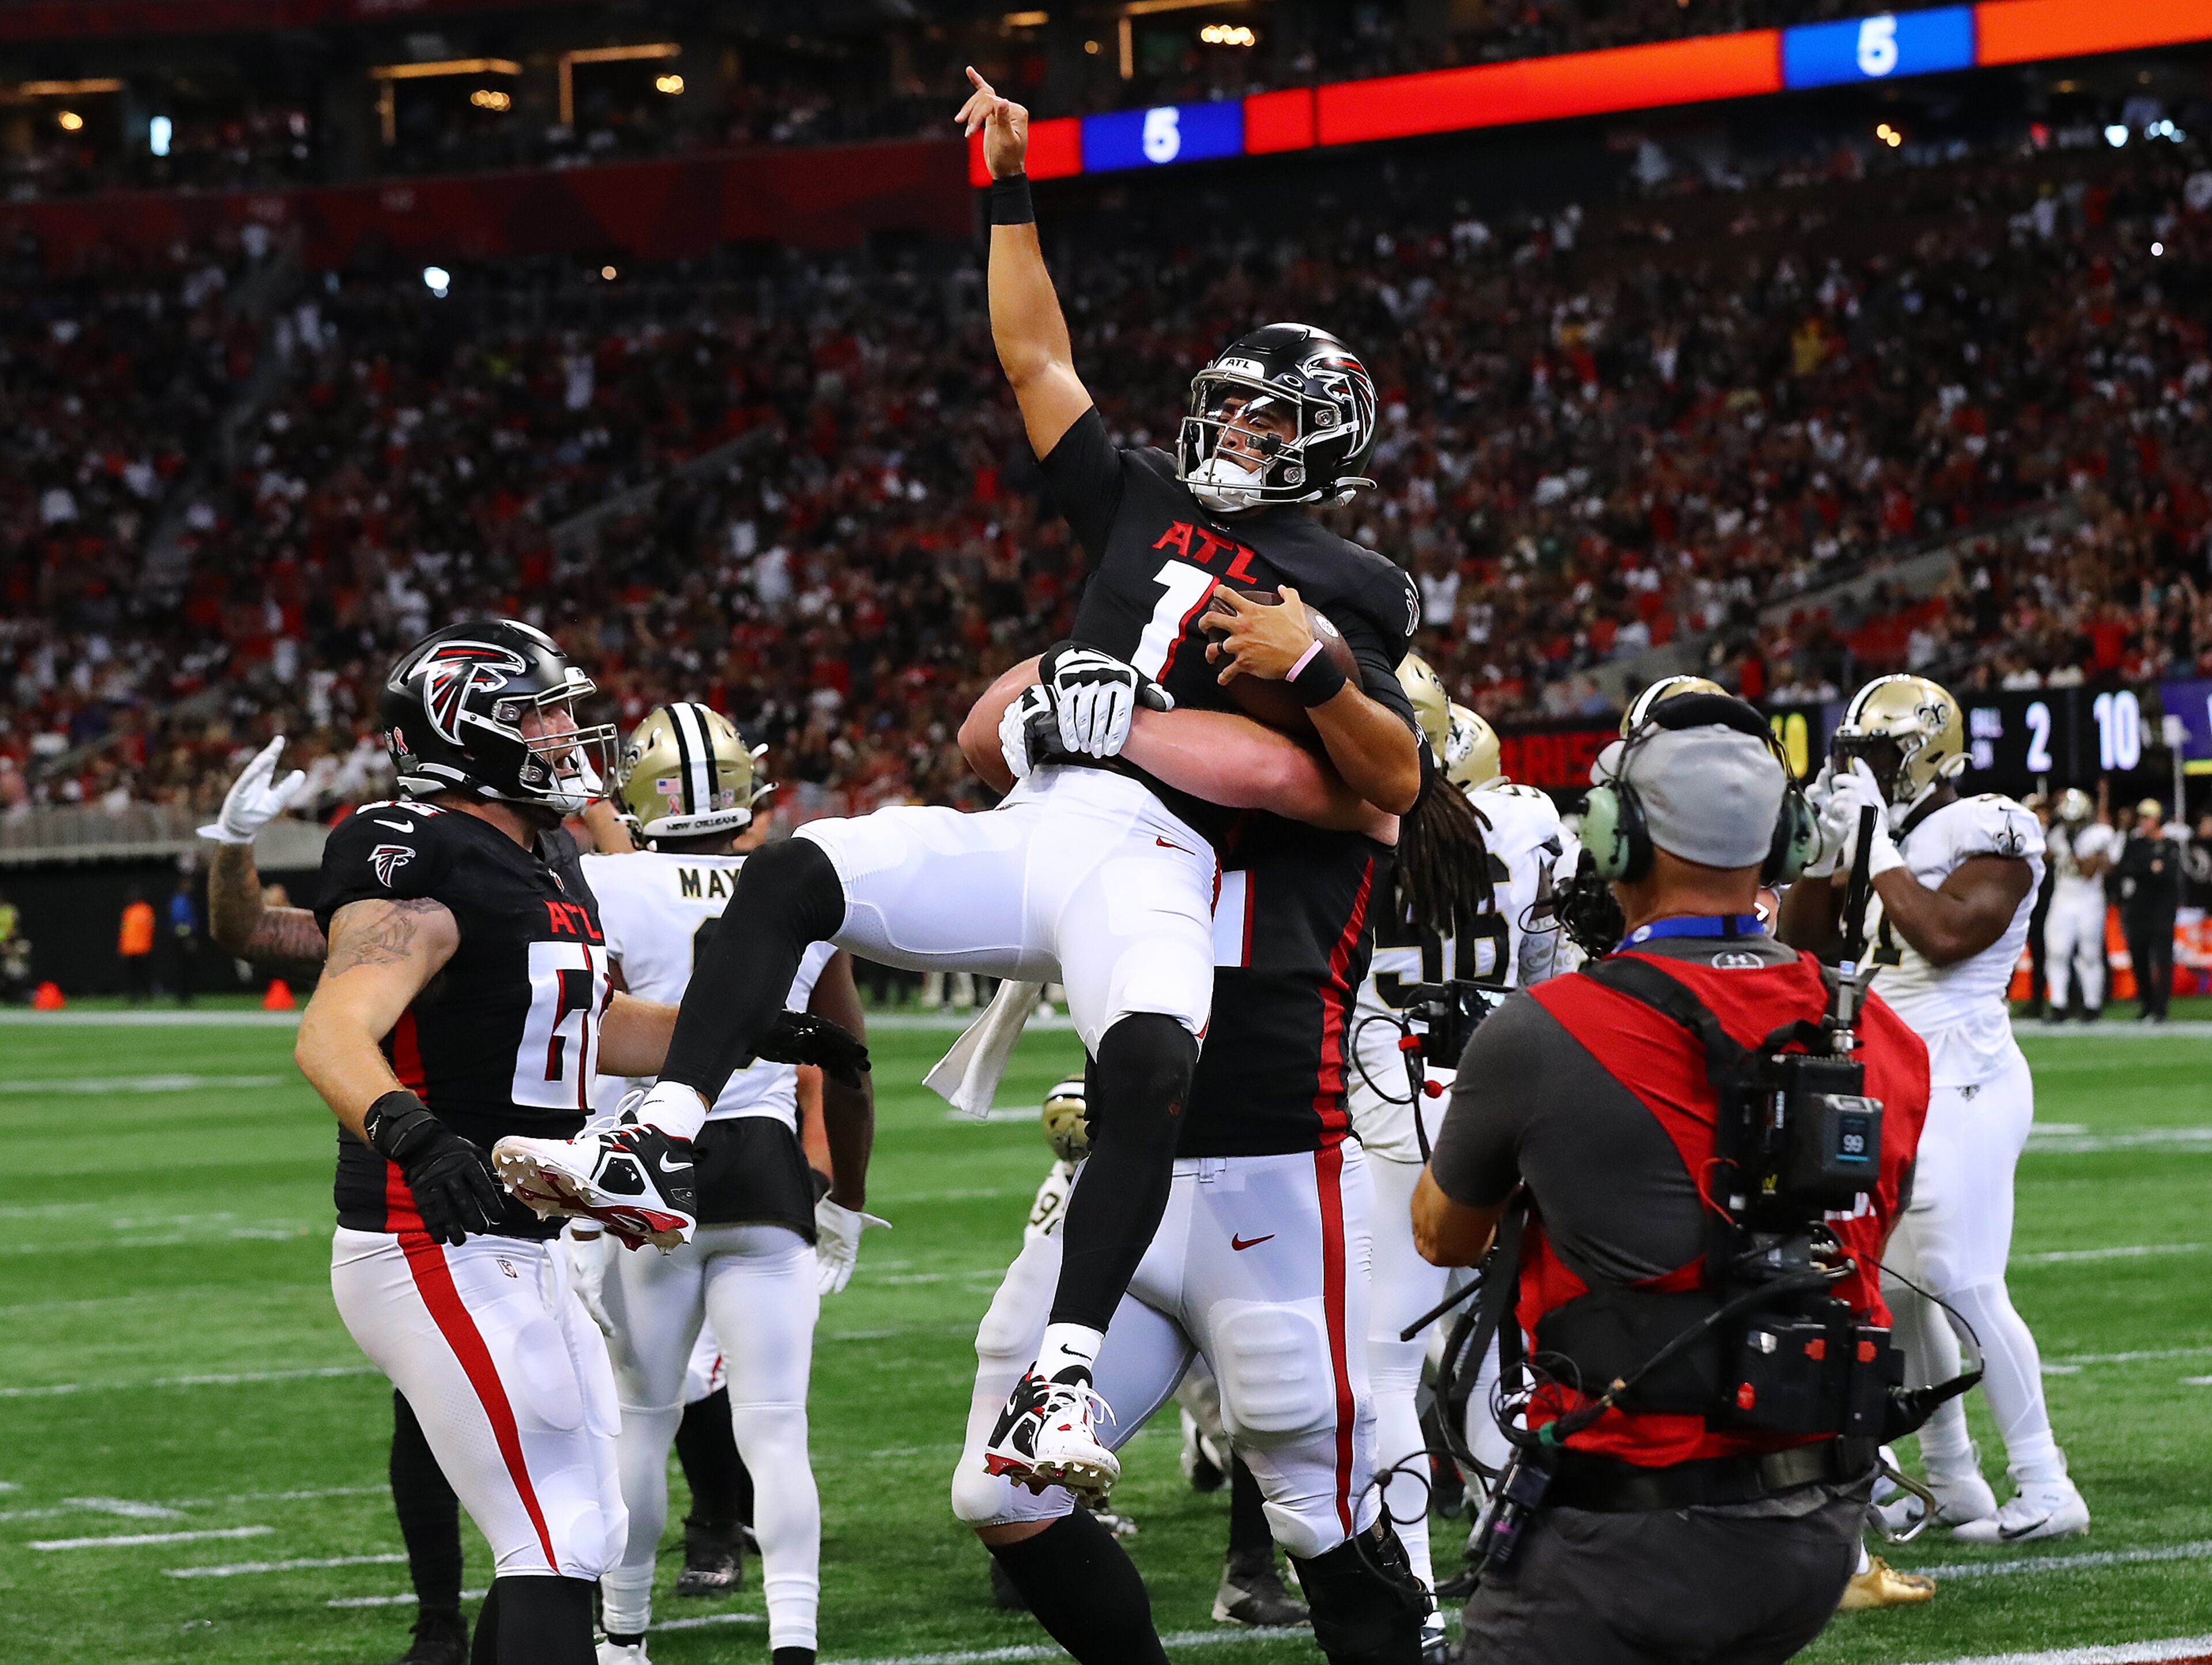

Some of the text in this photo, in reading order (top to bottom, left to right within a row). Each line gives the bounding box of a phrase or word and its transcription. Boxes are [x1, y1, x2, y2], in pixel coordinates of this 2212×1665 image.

[1857, 16, 1899, 76] 5
[1143, 107, 1180, 163] 5
[1226, 359, 1250, 369] ATL
[1153, 520, 1257, 585] ATL
[1130, 559, 1221, 685] 1
[2026, 701, 2052, 772] 2
[2093, 691, 2141, 771] 10
[666, 822, 691, 830] NEW
